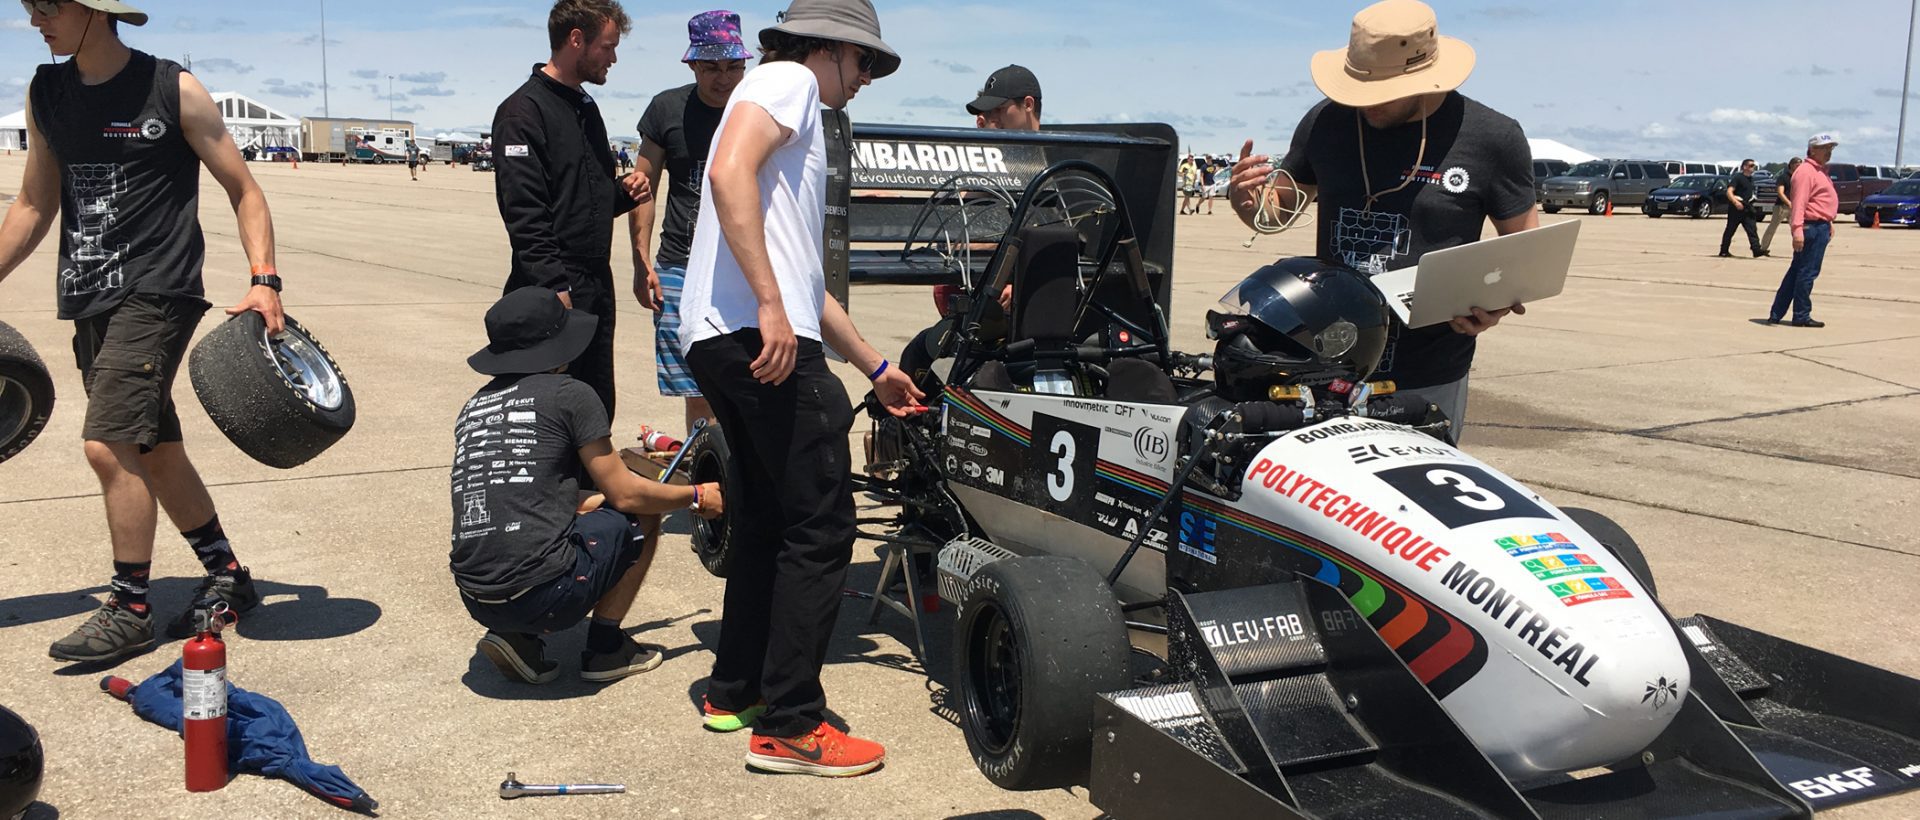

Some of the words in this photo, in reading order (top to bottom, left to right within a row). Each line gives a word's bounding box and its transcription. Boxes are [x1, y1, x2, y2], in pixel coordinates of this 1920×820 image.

[851, 142, 1008, 173] MBARDIER
[929, 175, 946, 187] de
[986, 466, 1005, 487] 3M
[1047, 430, 1076, 502] 3
[1425, 468, 1506, 511] 3
[1248, 458, 1450, 572] POLYTECHNIQUE
[1439, 561, 1600, 688] MONTRÉAL
[1788, 766, 1877, 799] SKF
